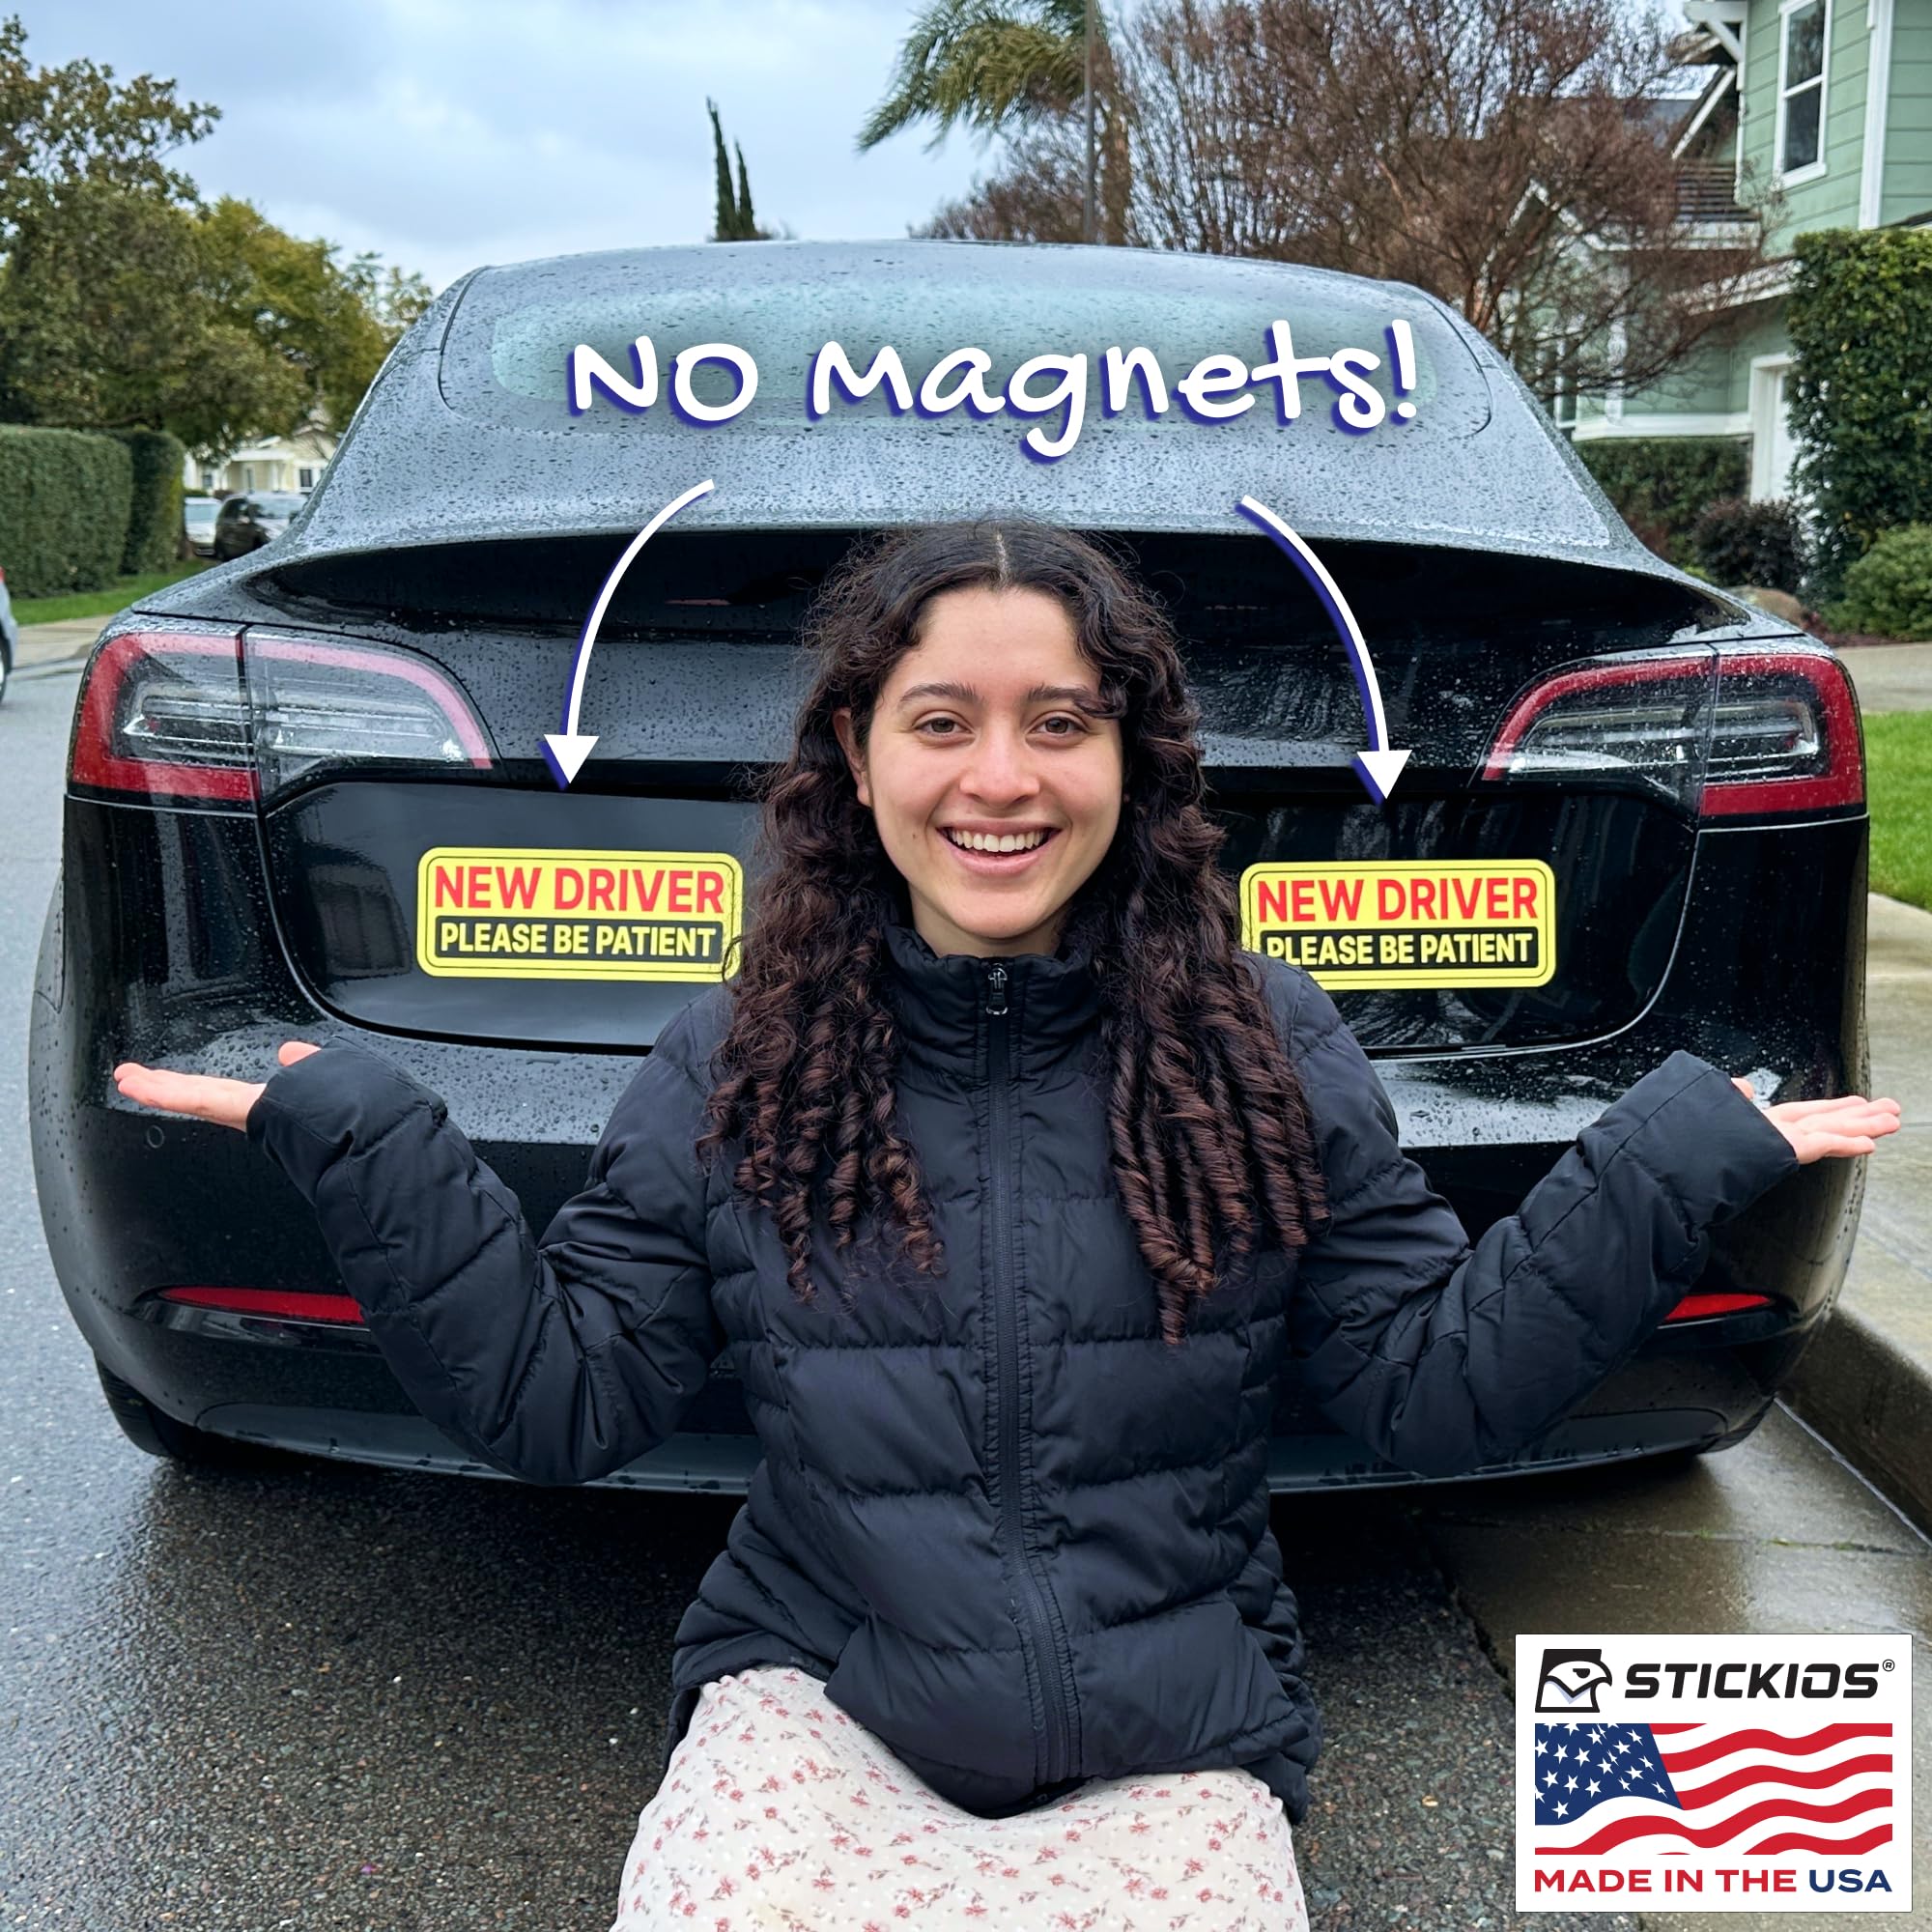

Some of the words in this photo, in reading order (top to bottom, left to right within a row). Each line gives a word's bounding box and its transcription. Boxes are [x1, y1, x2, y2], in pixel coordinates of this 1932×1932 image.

[435, 866, 542, 909] NEW
[554, 867, 724, 914] DRIVER
[1258, 879, 1364, 923] NEW
[1377, 877, 1538, 921] DRIVER
[440, 923, 548, 954] PLEASE
[554, 924, 589, 954] BE
[596, 925, 717, 957] PATIENT
[1266, 934, 1374, 965] PLEASE
[1379, 934, 1415, 964] BE
[1421, 932, 1533, 963] PATIENT
